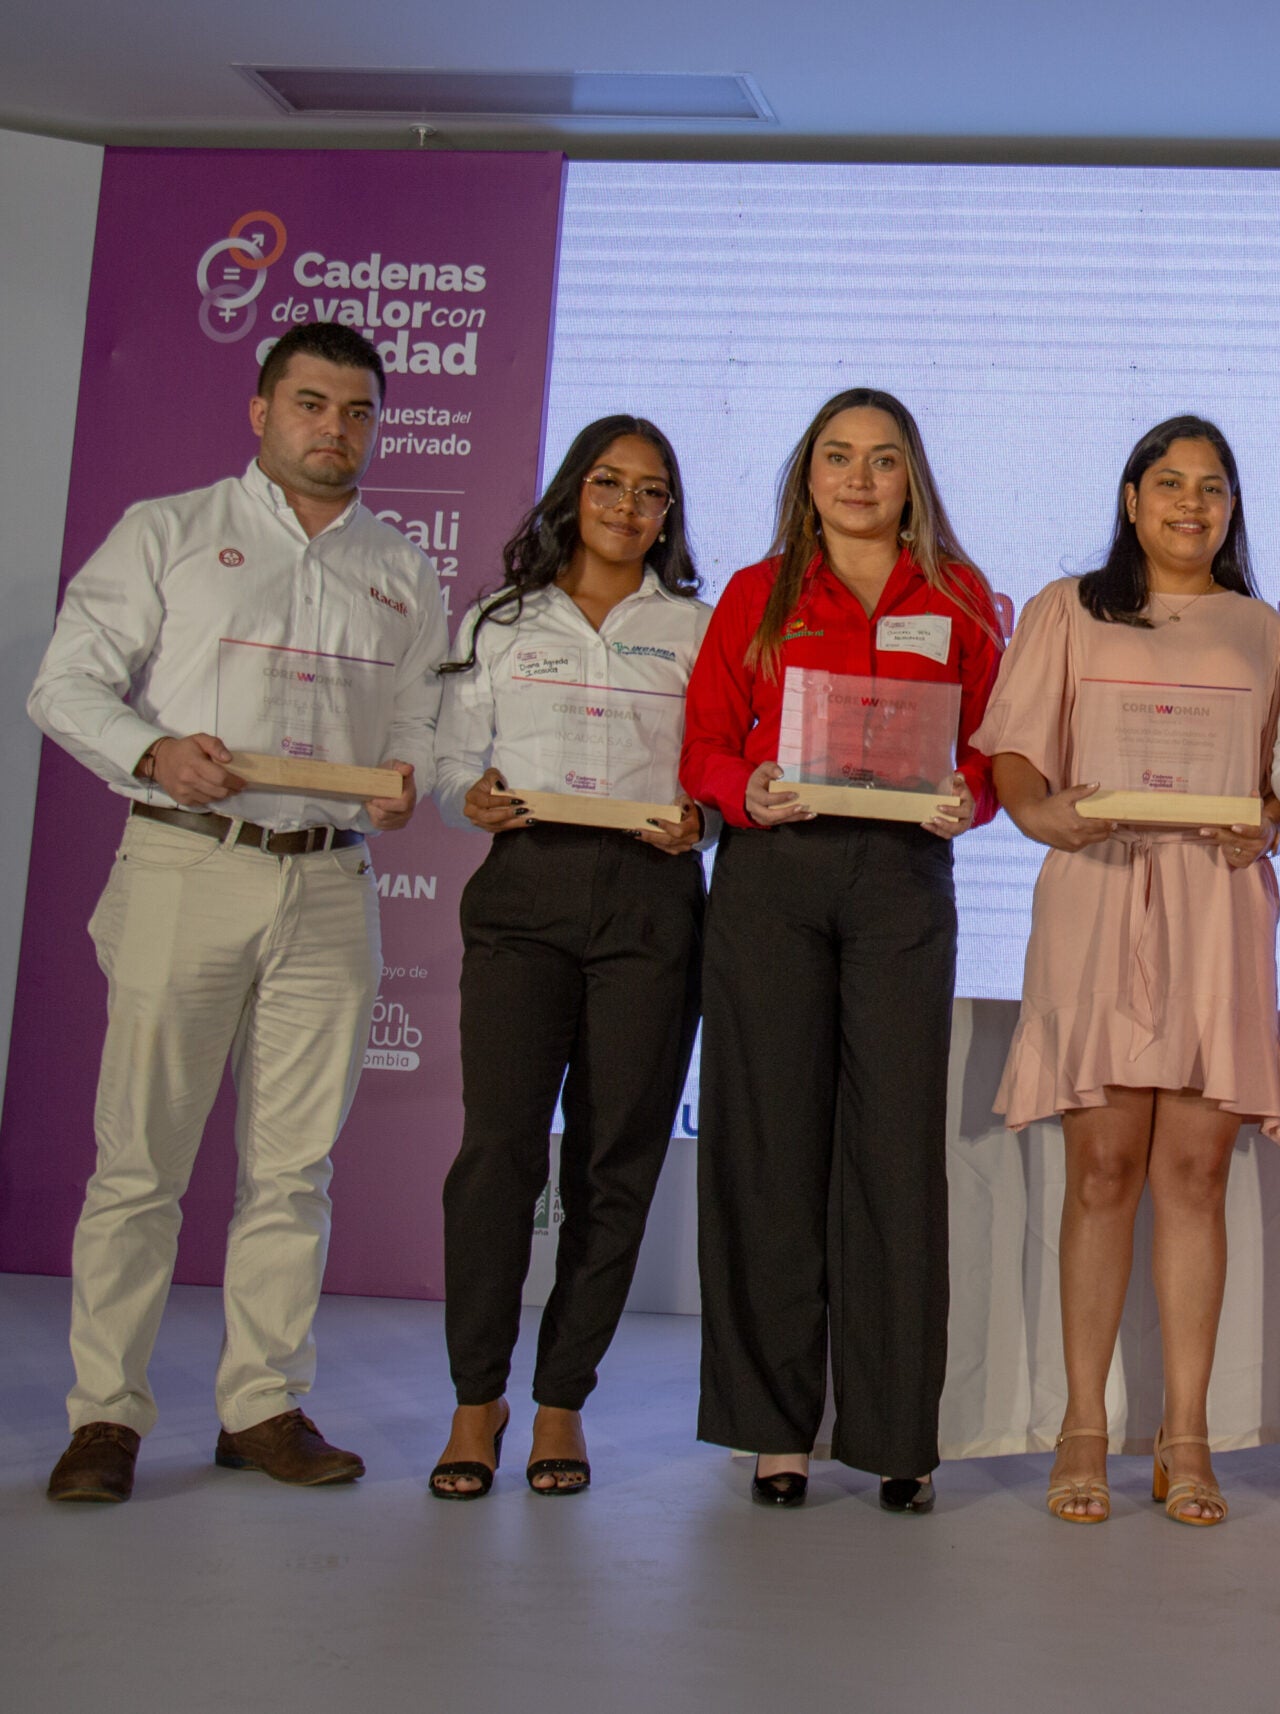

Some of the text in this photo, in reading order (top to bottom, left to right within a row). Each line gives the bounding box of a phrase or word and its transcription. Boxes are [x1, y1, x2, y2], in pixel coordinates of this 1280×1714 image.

[293, 252, 487, 291] Cadenas
[271, 291, 486, 328] de valor con
[452, 412, 472, 424] del
[381, 432, 472, 459] privado
[263, 667, 353, 687] COREWOMAN
[552, 703, 642, 721] COREWOMAN
[1122, 702, 1211, 717] COREWOMAN
[409, 965, 428, 979] de
